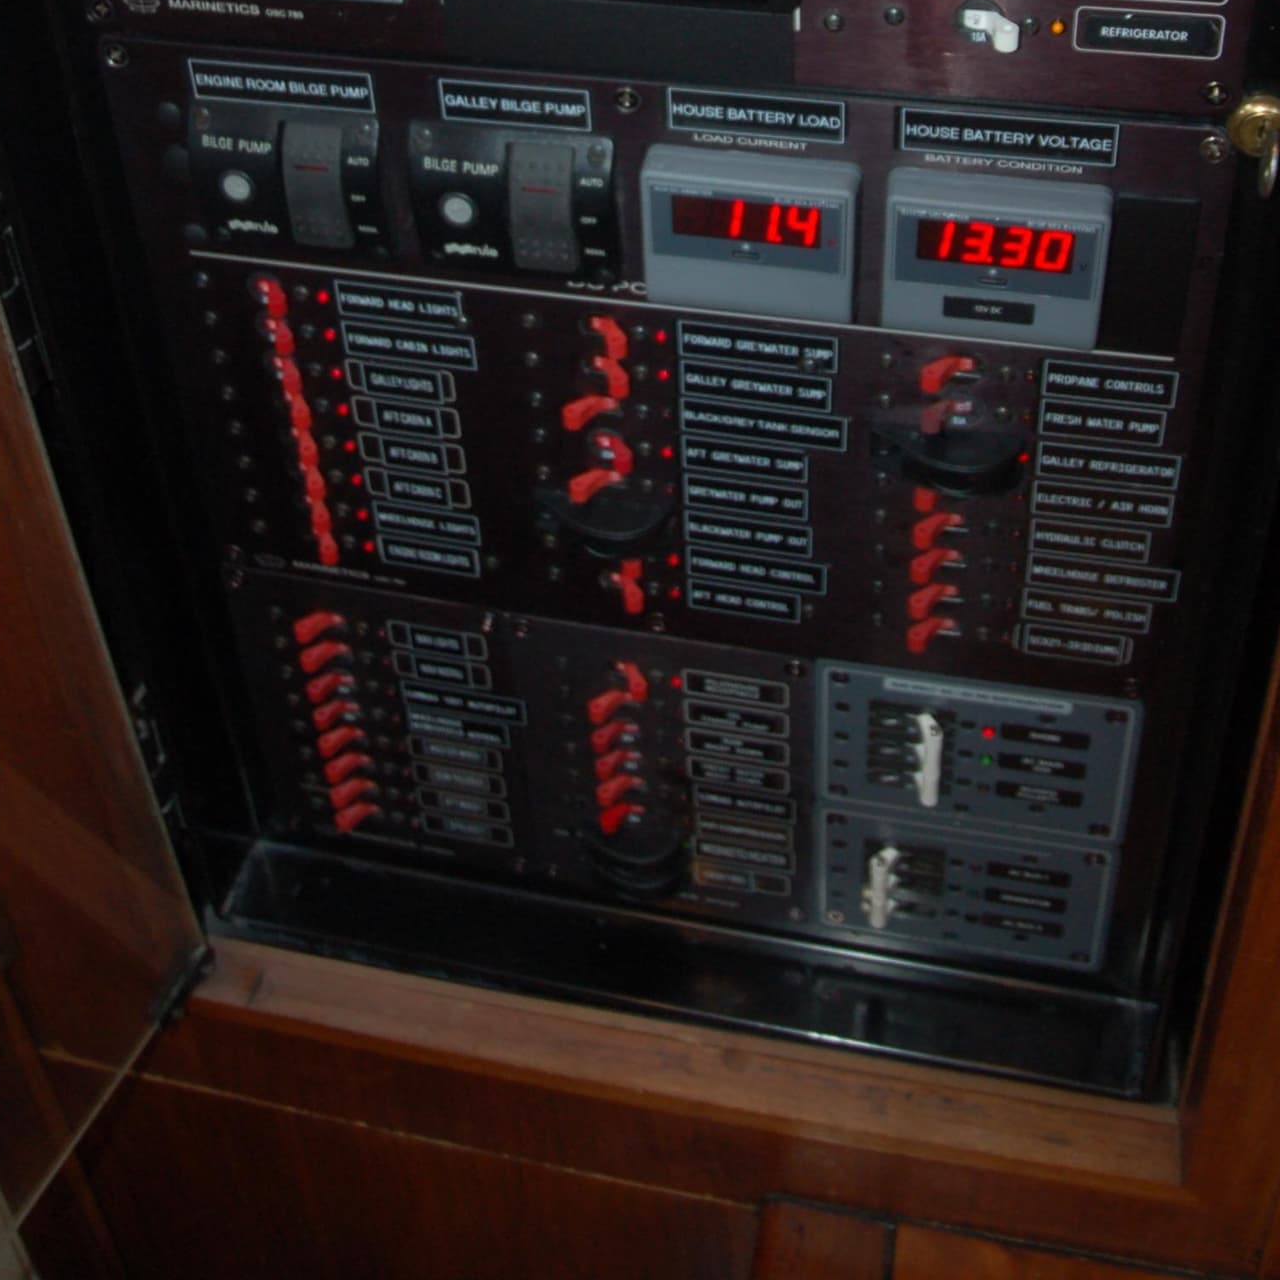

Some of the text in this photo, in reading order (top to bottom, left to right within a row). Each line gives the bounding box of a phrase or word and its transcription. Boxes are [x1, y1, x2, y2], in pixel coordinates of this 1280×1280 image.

[1100, 25, 1188, 43] REFRIGERATOR
[196, 74, 243, 89] ENGINE
[289, 81, 328, 96] BILGE
[330, 84, 368, 99] PUMP
[445, 94, 586, 117] GALLEY BILGE PUMP
[672, 102, 841, 129] HOUSE BATTERY LOAD
[202, 134, 272, 154] BILGE PUMP
[906, 123, 1113, 151] HOUSE BATTERY VOLTAGE
[423, 156, 498, 176] BILGE PUMP
[729, 199, 819, 248] 11.4
[938, 220, 1074, 272] 13.30
